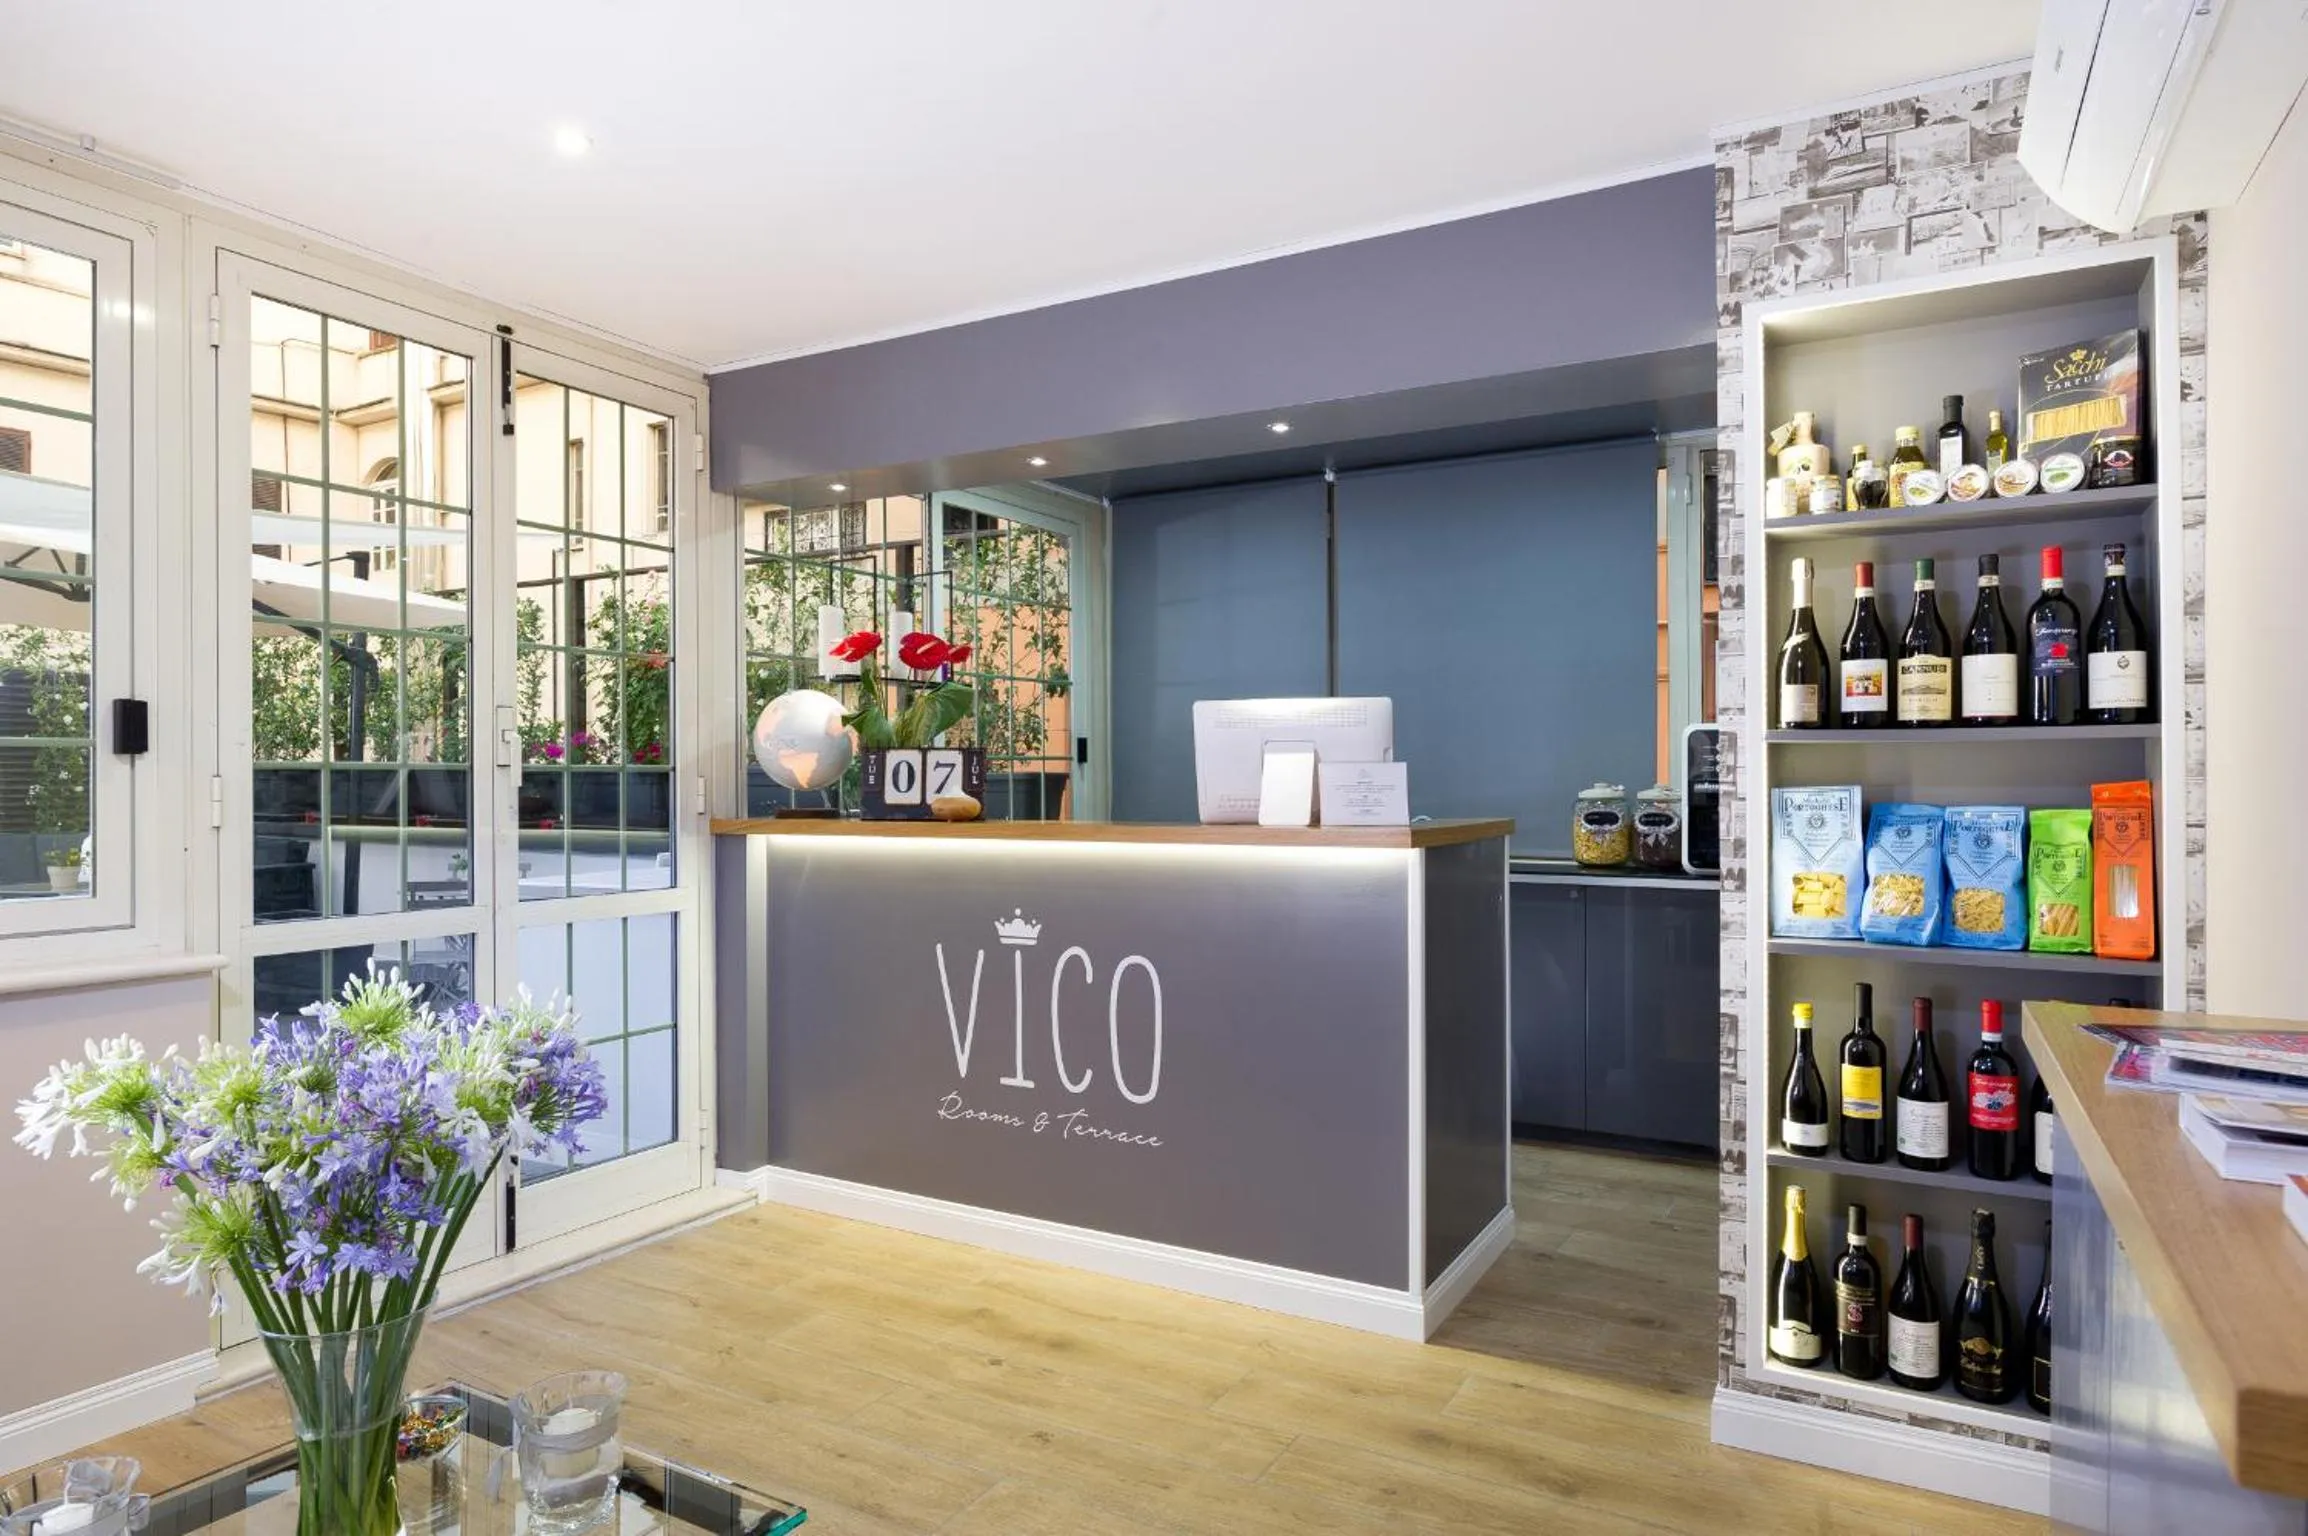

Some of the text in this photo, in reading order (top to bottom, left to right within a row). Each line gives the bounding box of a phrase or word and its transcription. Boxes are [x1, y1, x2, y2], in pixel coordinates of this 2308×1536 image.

[868, 755, 877, 784] TUE
[971, 756, 979, 785] JUL
[935, 943, 1163, 1104] VICO
[937, 1091, 1165, 1147] Rooms & Terrace
